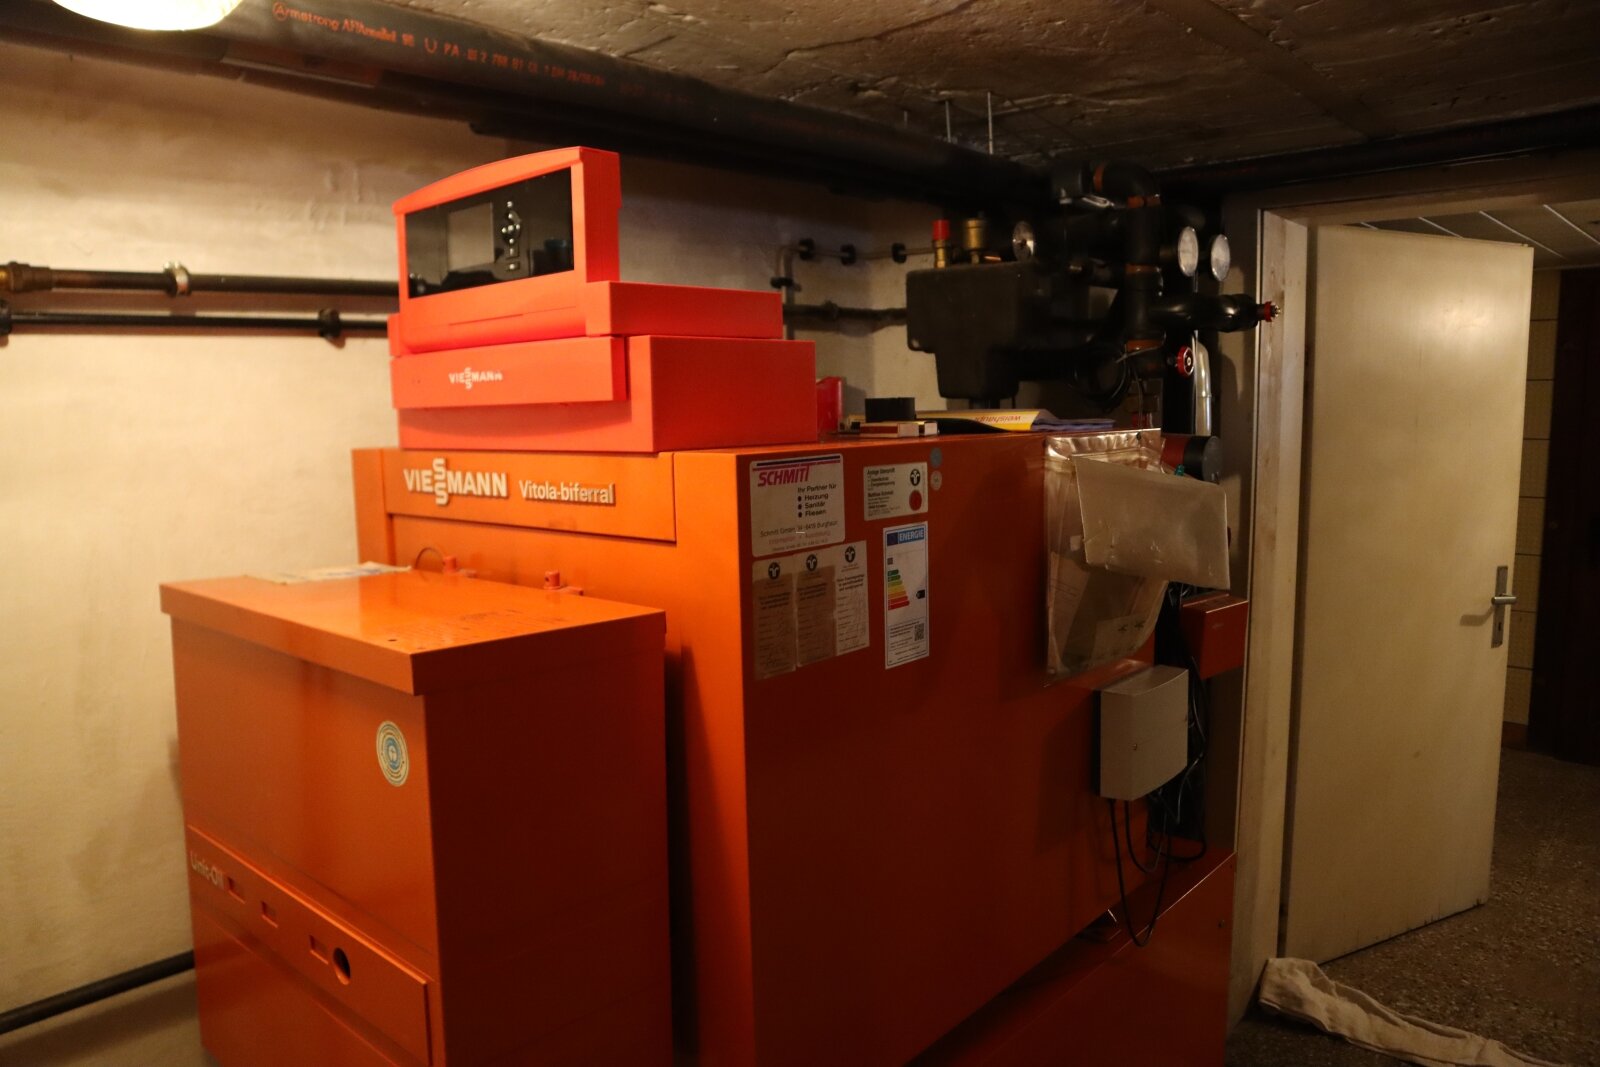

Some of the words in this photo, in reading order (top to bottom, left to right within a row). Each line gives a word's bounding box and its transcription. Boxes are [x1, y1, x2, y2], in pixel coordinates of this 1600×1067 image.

[272, 2, 339, 31] Armstrong
[448, 366, 503, 390] VIESSMANN
[403, 457, 508, 505] VIESSMANN
[519, 480, 615, 505] Vitola-biferral
[757, 465, 811, 487] SCHMITT
[804, 493, 829, 502] Heizung
[806, 485, 828, 493] Partner
